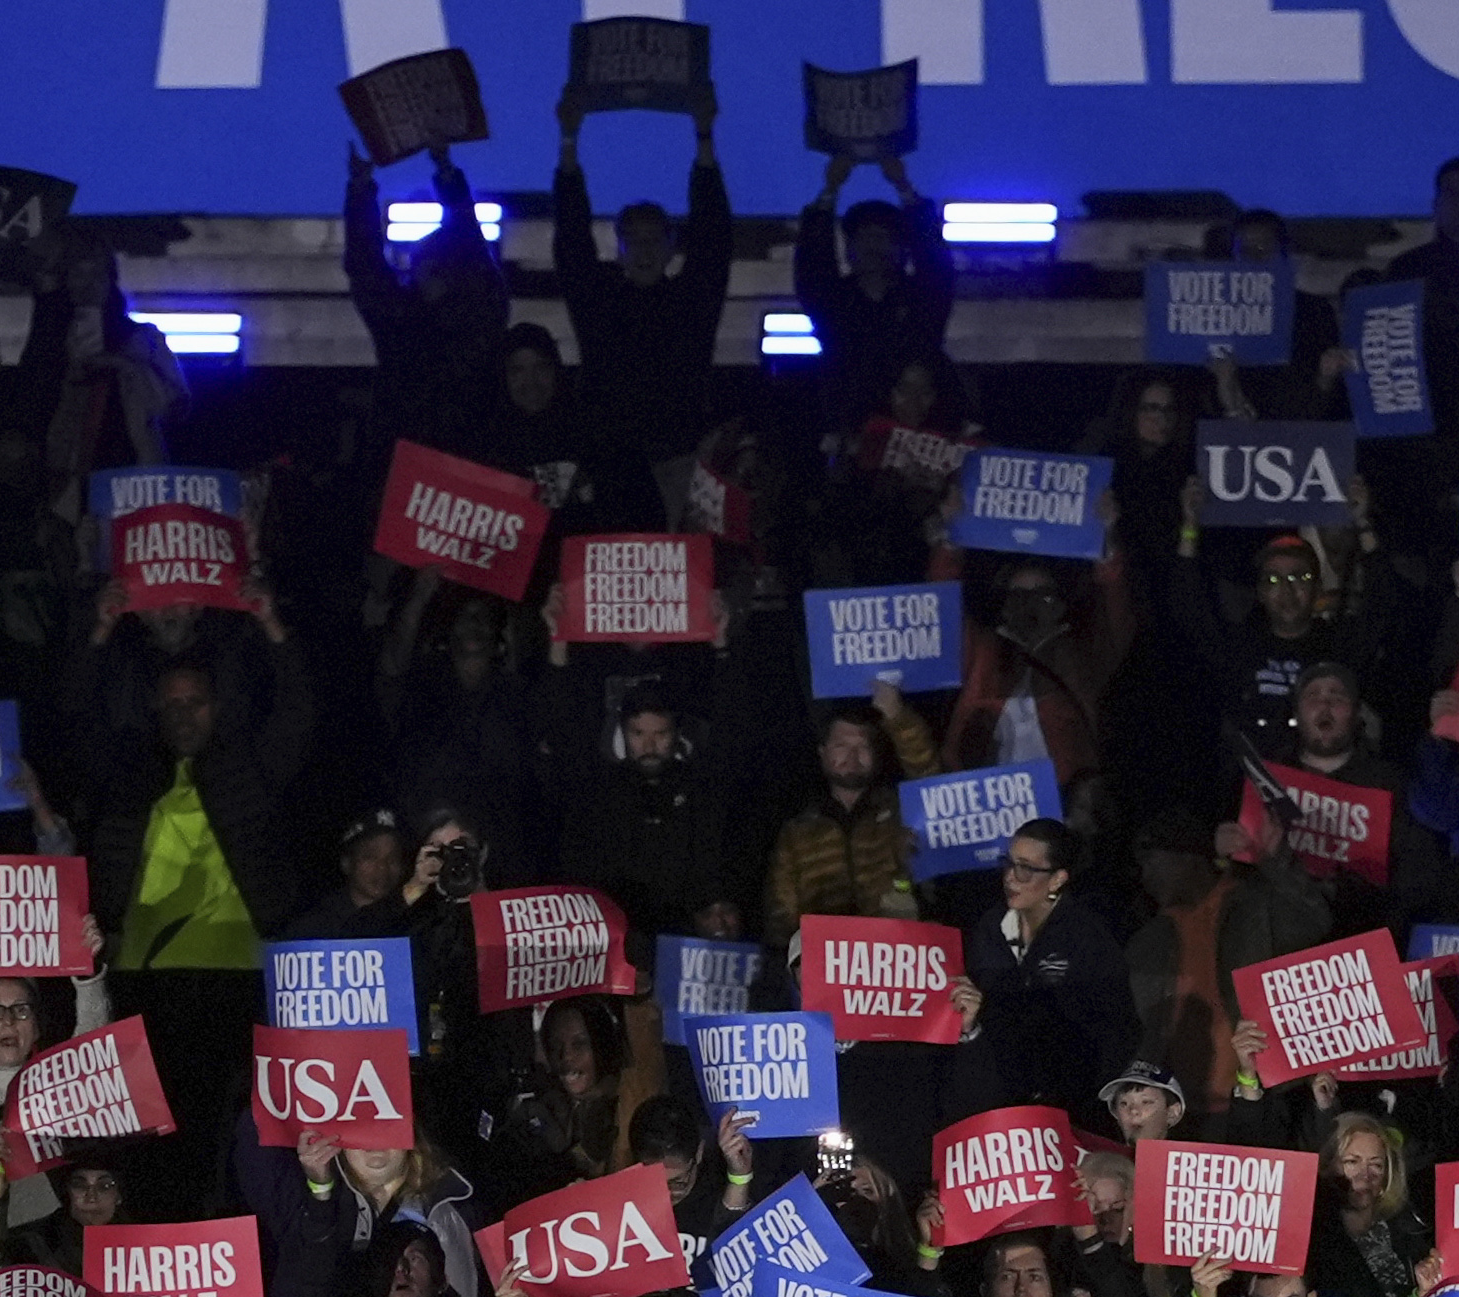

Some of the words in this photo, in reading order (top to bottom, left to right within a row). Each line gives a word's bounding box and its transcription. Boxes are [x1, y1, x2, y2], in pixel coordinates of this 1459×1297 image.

[1206, 446, 1346, 502] USA
[406, 483, 523, 549] HARRIS
[417, 527, 494, 568] WALZ
[826, 941, 946, 990] HARRIS
[844, 989, 926, 1016] WALZ
[257, 1056, 403, 1122] USA
